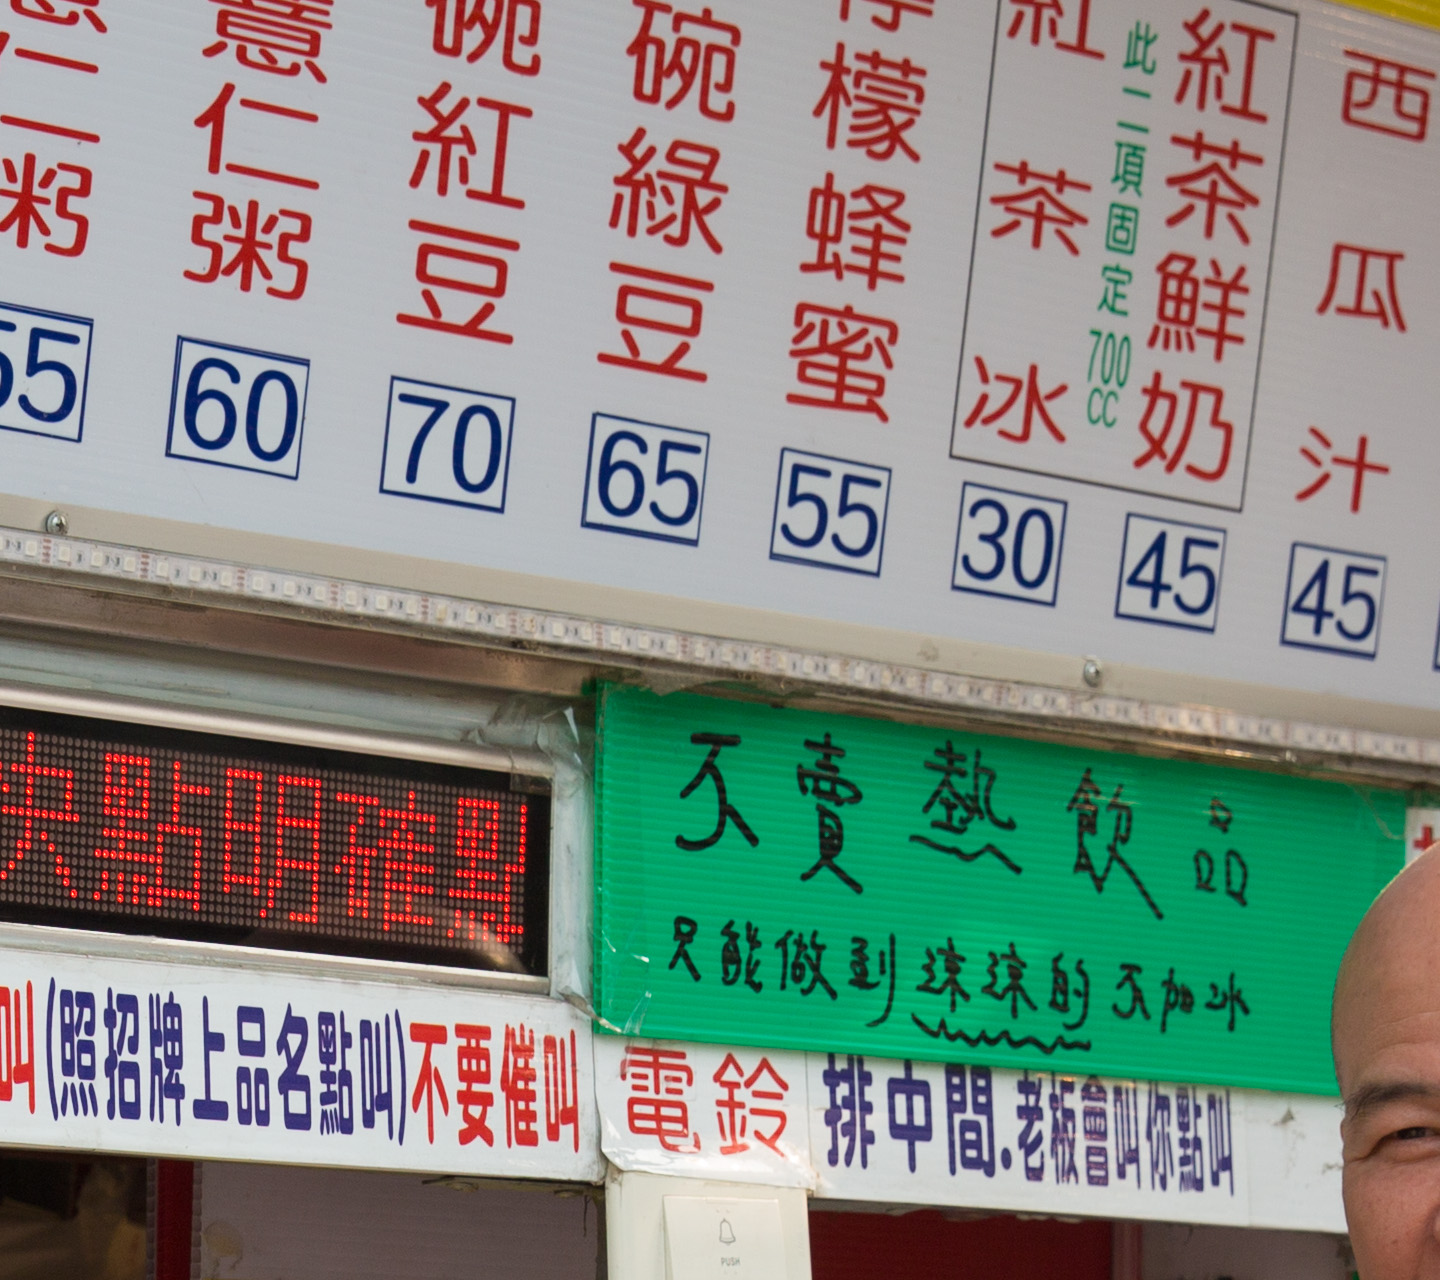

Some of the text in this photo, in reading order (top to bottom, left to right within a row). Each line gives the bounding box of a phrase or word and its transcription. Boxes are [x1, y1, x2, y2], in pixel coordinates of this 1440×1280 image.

[1132, 8, 1276, 484] 紅茶鮮奶
[1294, 50, 1437, 515] 西瓜汁
[182, 357, 300, 463] 60
[396, 392, 503, 495] 70
[596, 430, 700, 527] 65
[780, 464, 881, 557] 55
[962, 498, 1055, 590] 30
[1125, 527, 1220, 617] 45
[1290, 564, 1378, 643] 45
[620, 1045, 790, 1160] 電鈴
